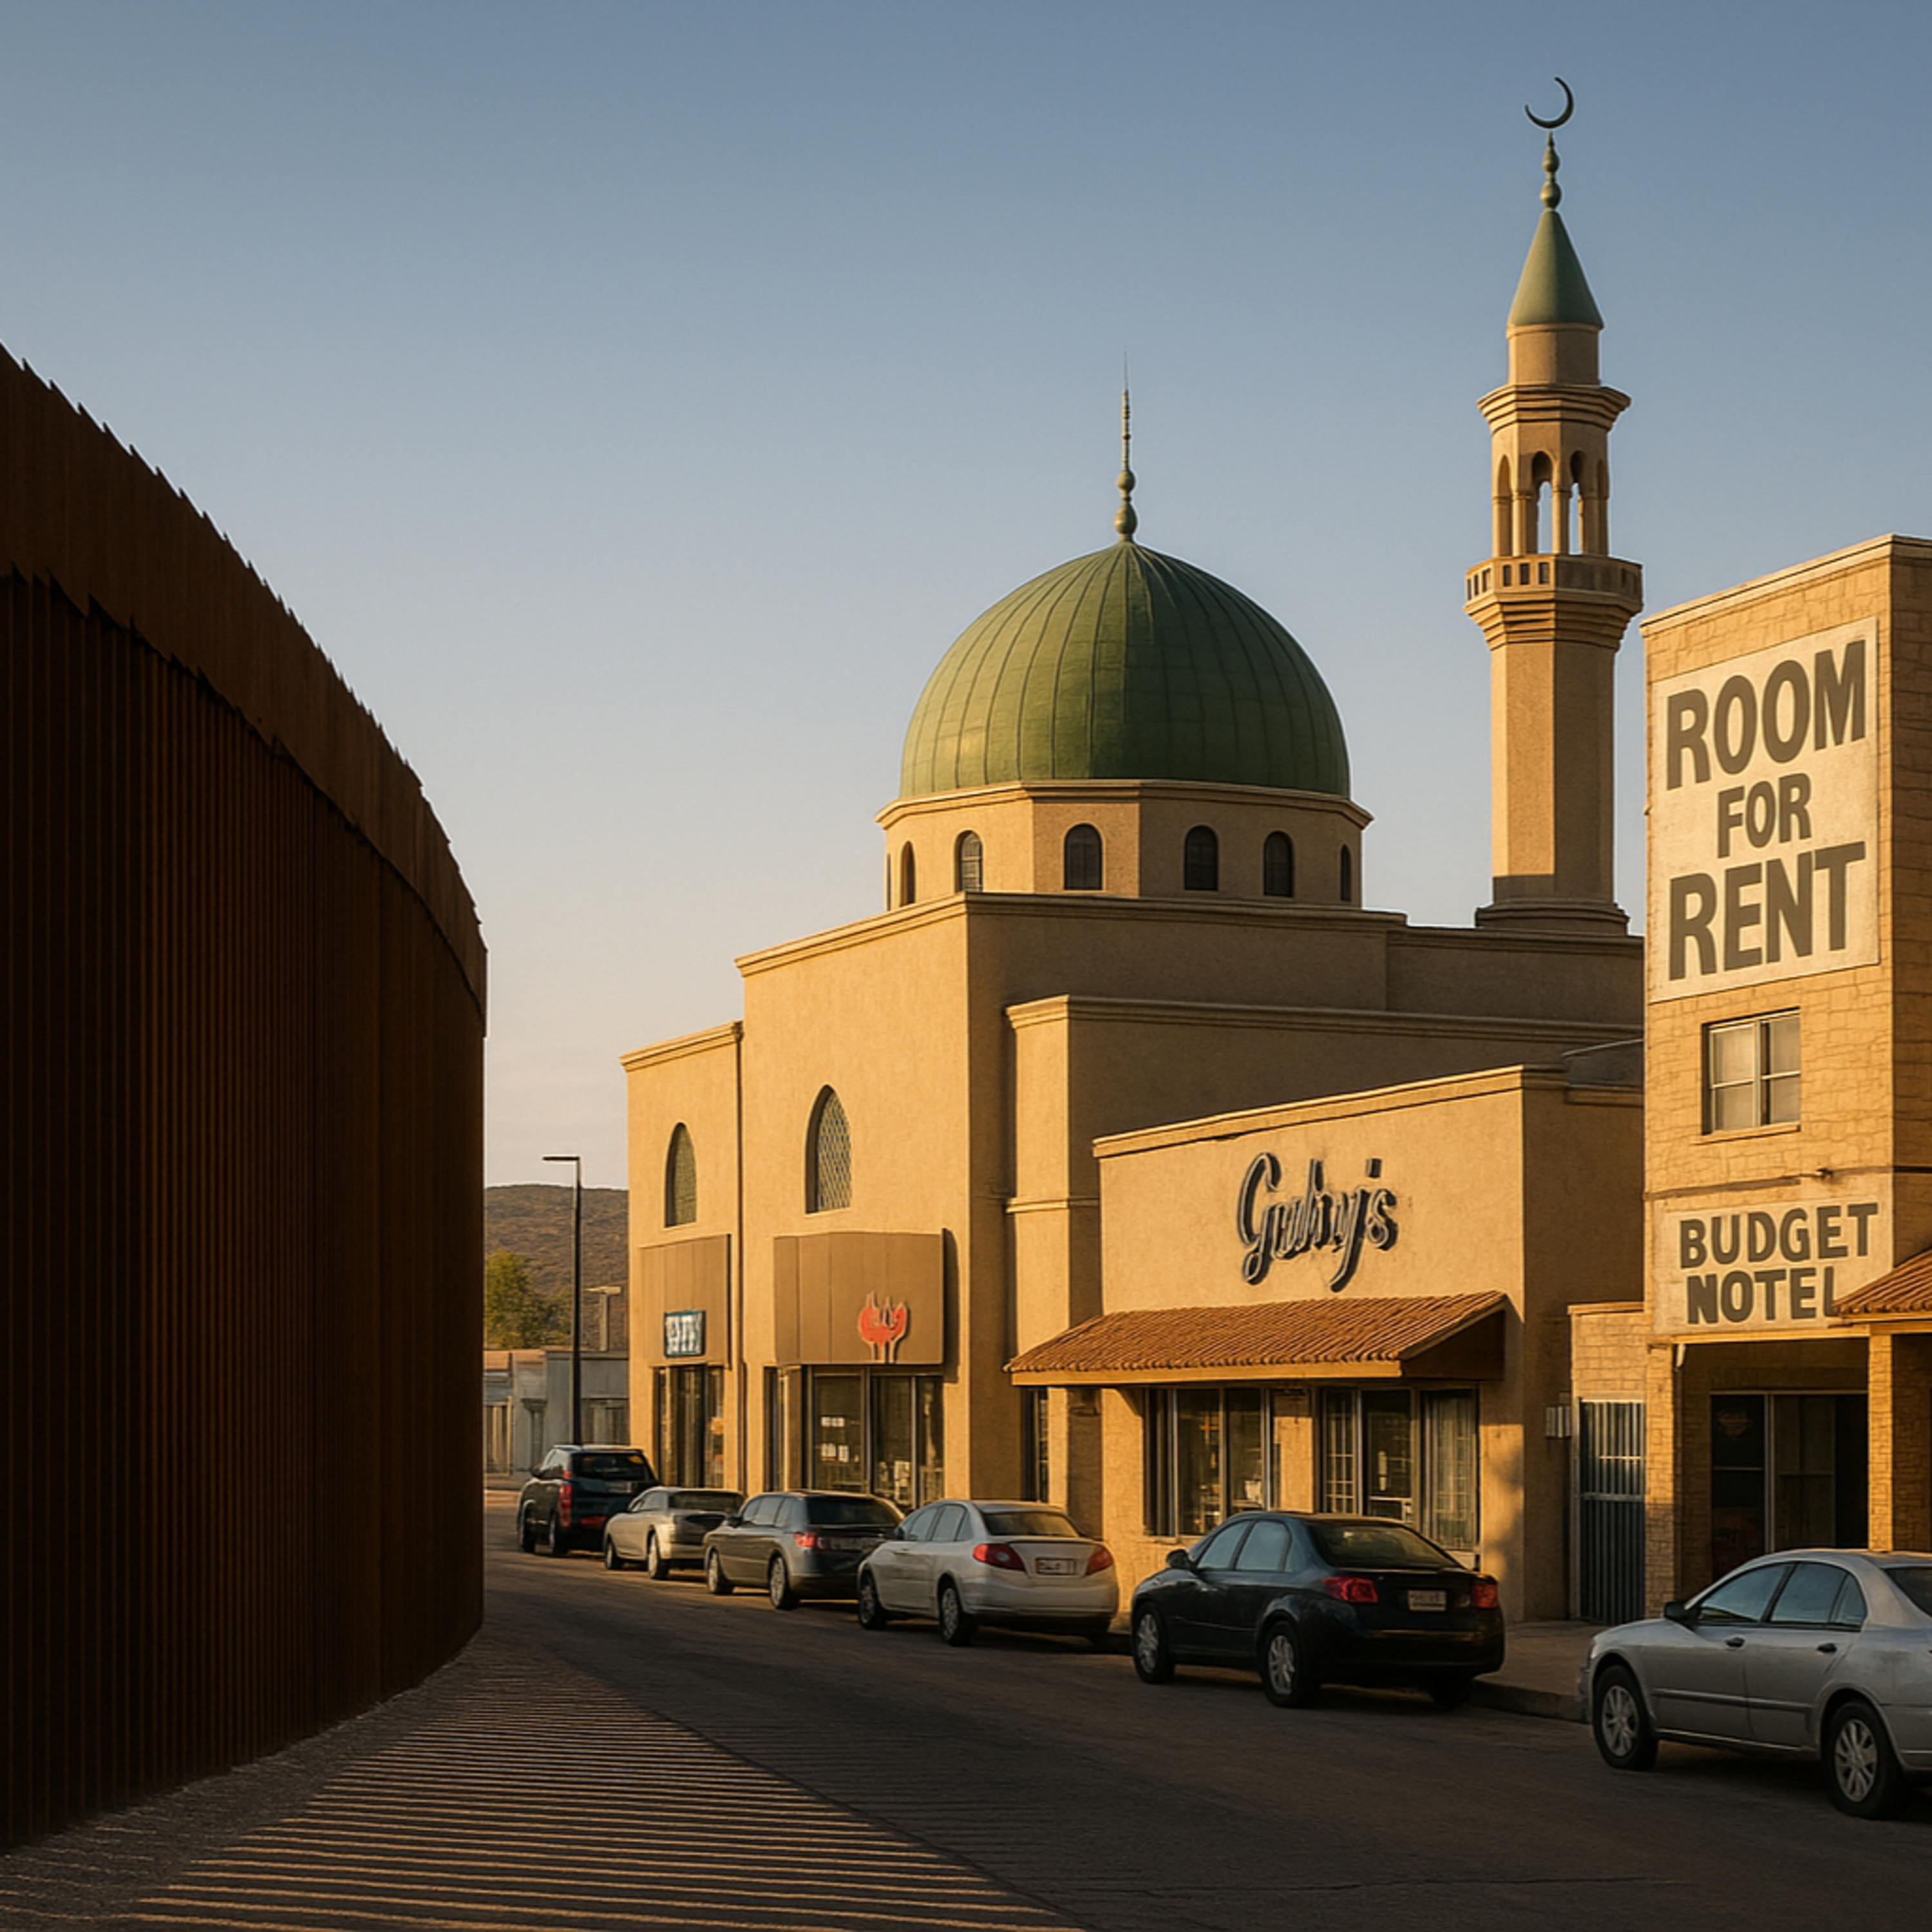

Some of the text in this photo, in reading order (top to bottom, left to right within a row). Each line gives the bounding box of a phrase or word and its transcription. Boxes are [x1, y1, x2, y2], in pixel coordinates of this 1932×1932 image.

[1666, 638, 1866, 791] ROOM
[1717, 772, 1812, 859] FOR
[1669, 840, 1866, 981] RENT
[1680, 1202, 1879, 1269] BUDGET
